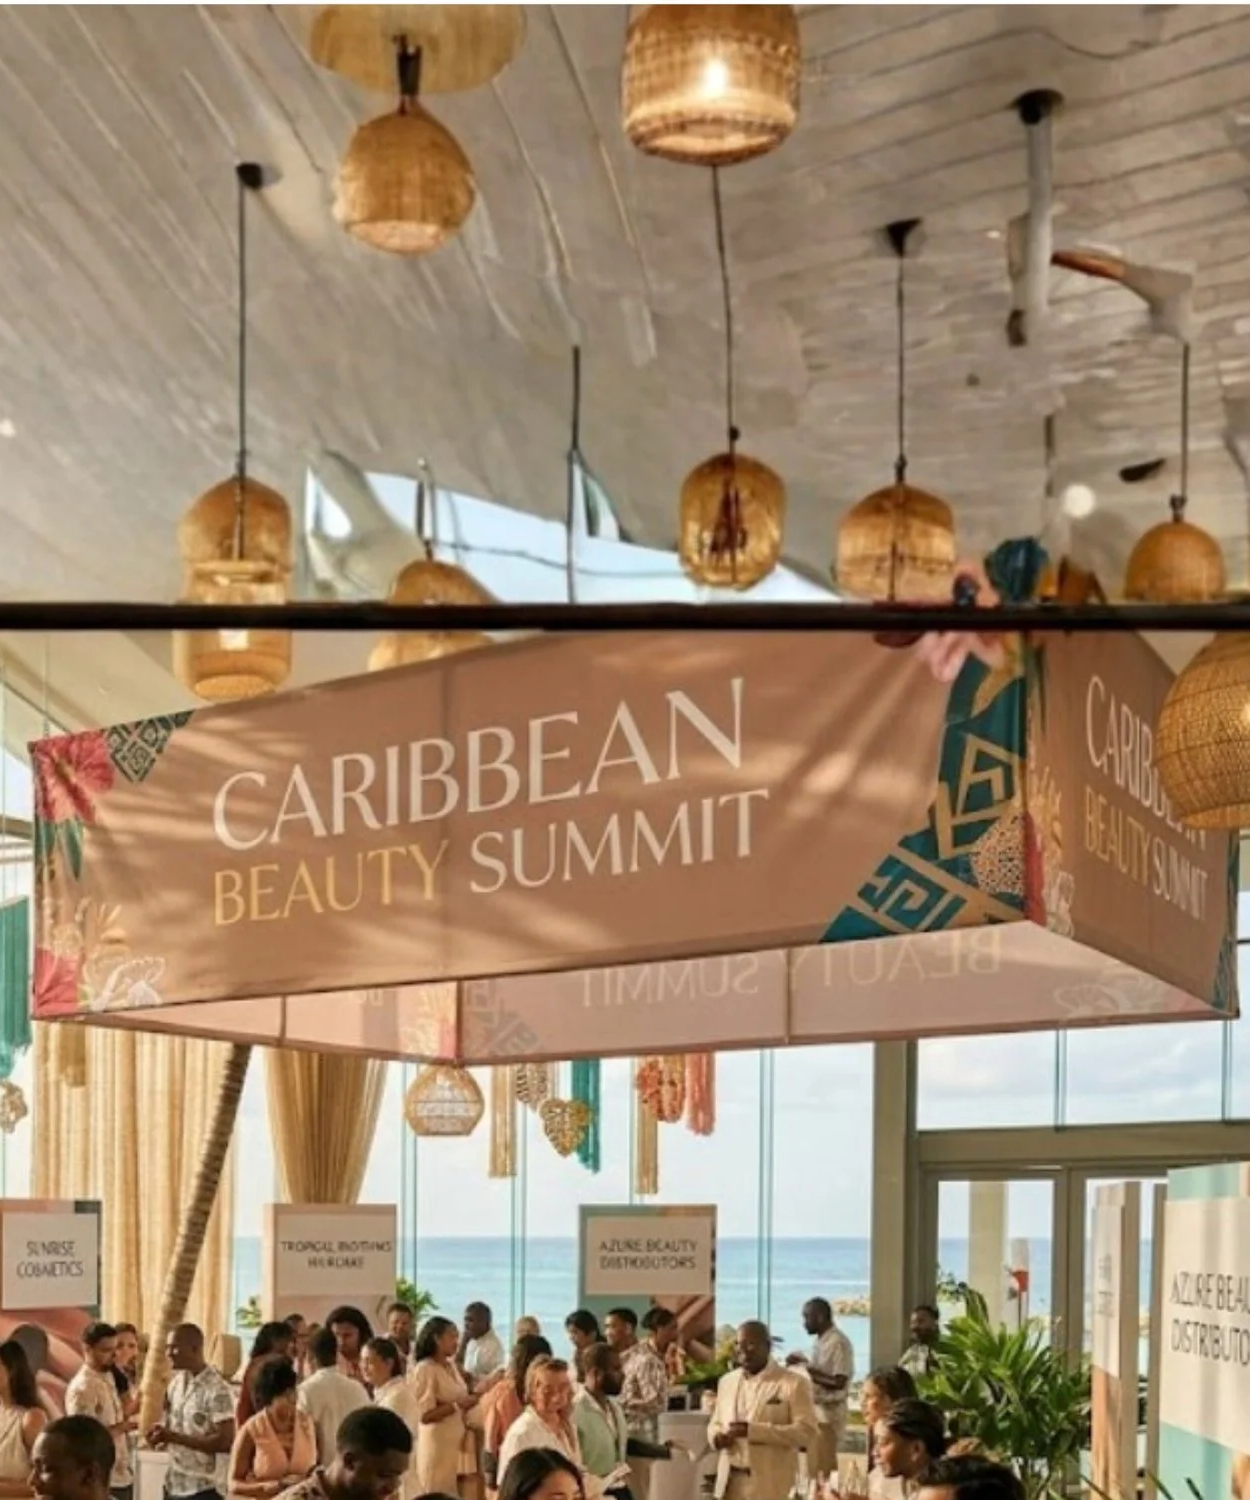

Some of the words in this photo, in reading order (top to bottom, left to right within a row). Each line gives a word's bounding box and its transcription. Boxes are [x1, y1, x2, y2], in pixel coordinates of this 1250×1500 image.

[213, 677, 745, 850] CARIBBEAN
[1086, 674, 1207, 850] CARIB
[213, 839, 450, 926] BEAUTY
[469, 788, 770, 894] SUMMIT
[1085, 784, 1151, 887] BEAUTY
[1153, 836, 1208, 921] SUMMIT
